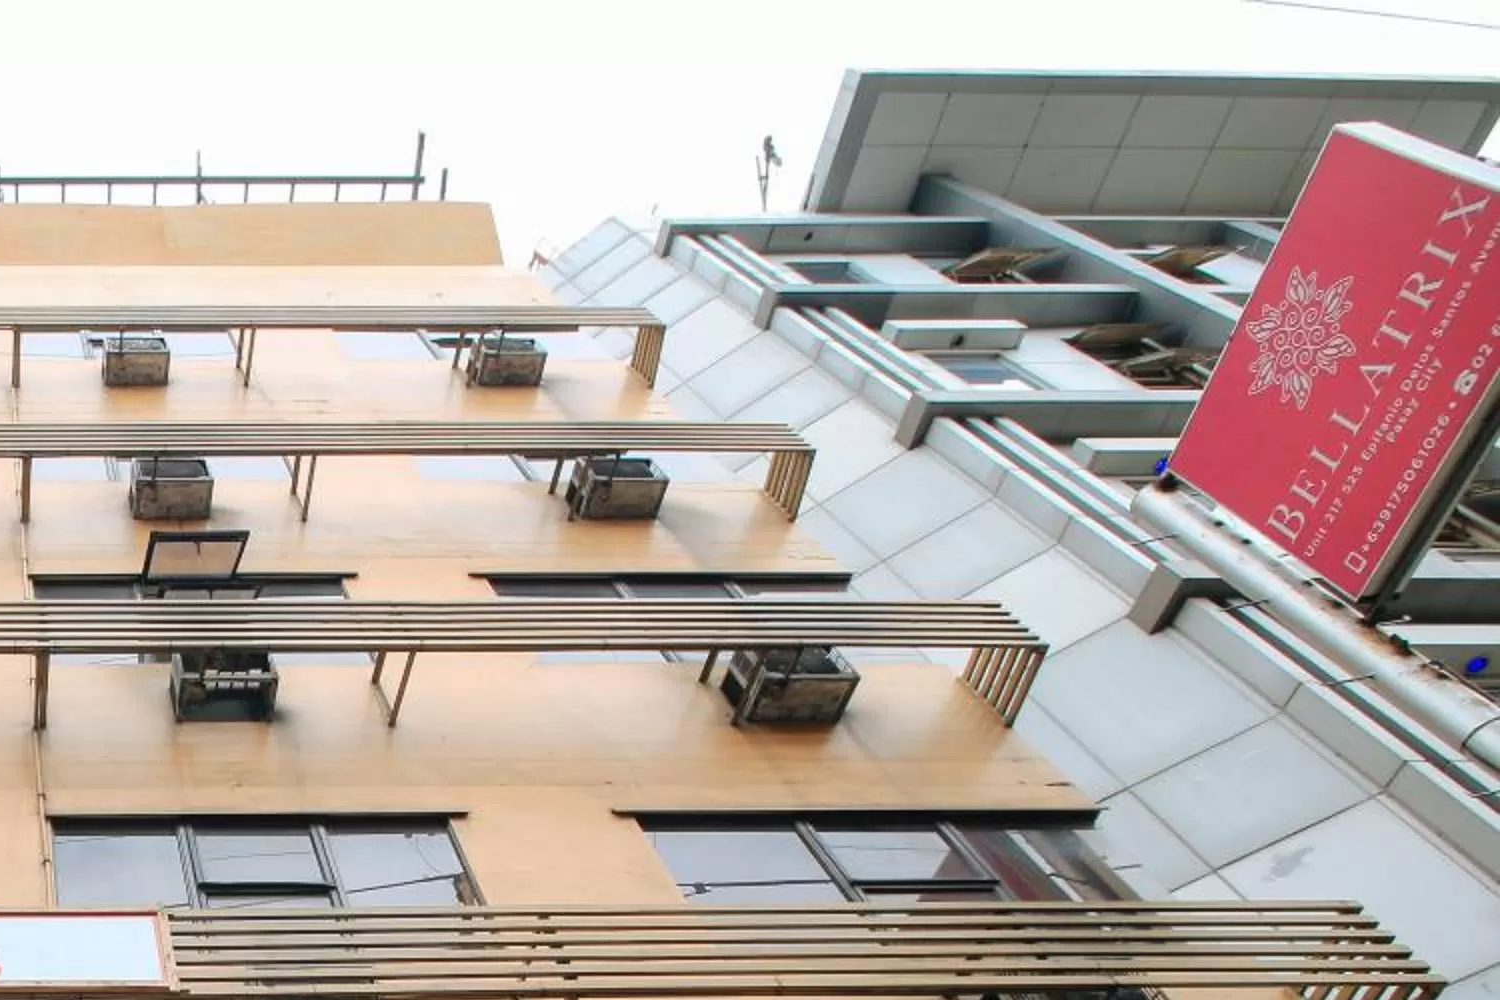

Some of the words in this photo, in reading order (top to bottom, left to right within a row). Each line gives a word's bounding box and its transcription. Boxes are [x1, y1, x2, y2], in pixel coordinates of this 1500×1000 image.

[1267, 184, 1492, 544] BELLATRIX
[1304, 527, 1328, 557] Unit
[1430, 281, 1472, 338] Santos
[1469, 221, 1500, 274] Aven
[1386, 397, 1420, 443] Pasay
[1416, 357, 1443, 391] City
